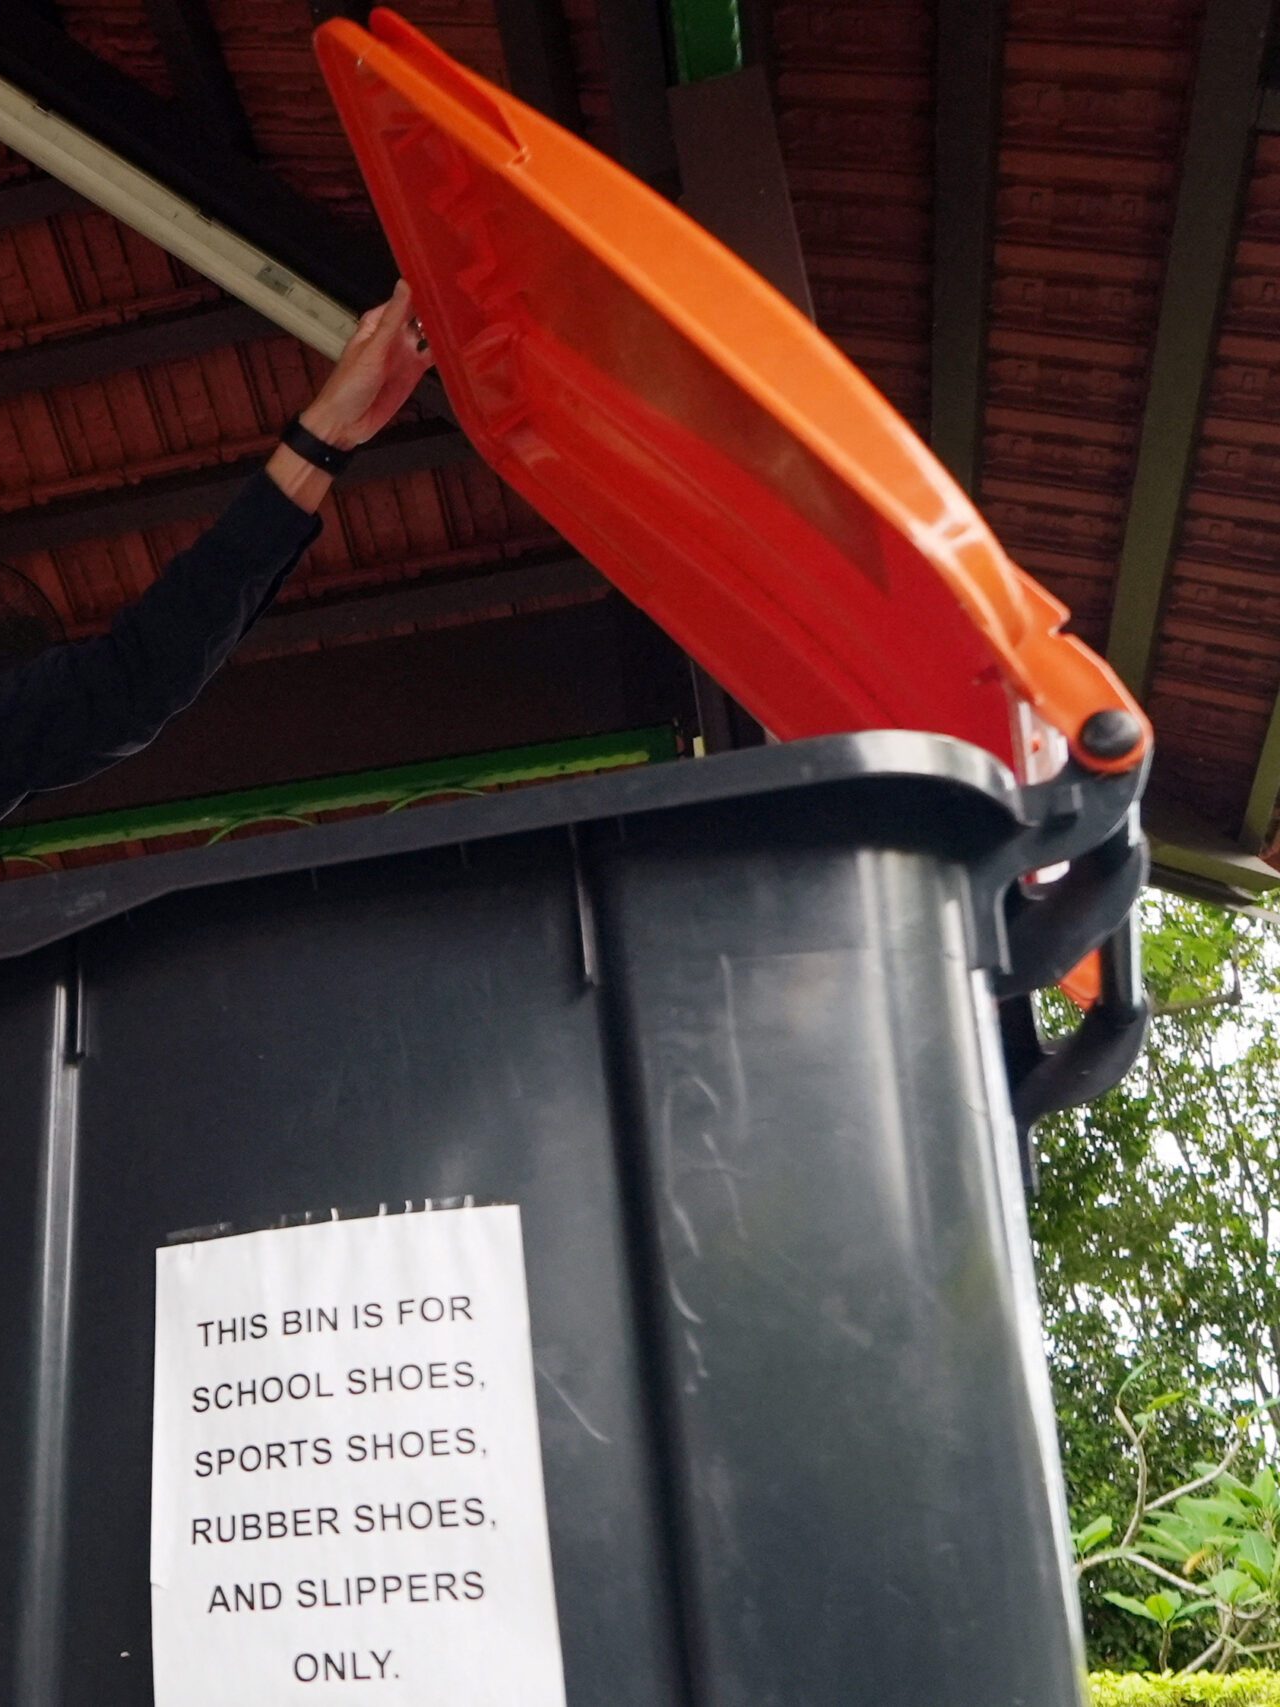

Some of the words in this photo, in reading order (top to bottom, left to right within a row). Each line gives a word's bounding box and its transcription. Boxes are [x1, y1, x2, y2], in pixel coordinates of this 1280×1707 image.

[196, 1312, 268, 1348] THIS
[282, 1303, 339, 1336] BIN
[353, 1302, 384, 1330] IS
[397, 1295, 473, 1326] FOR
[191, 1372, 335, 1414] SCHOOL
[346, 1360, 487, 1396] SHOES,
[194, 1437, 333, 1478] SPORTS
[346, 1427, 488, 1463] SHOES,
[191, 1506, 341, 1546] RUBBER
[353, 1497, 497, 1532] SHOES,
[207, 1581, 283, 1614] AND
[296, 1570, 485, 1609] SLIPPERS
[293, 1649, 400, 1683] ONLY.
